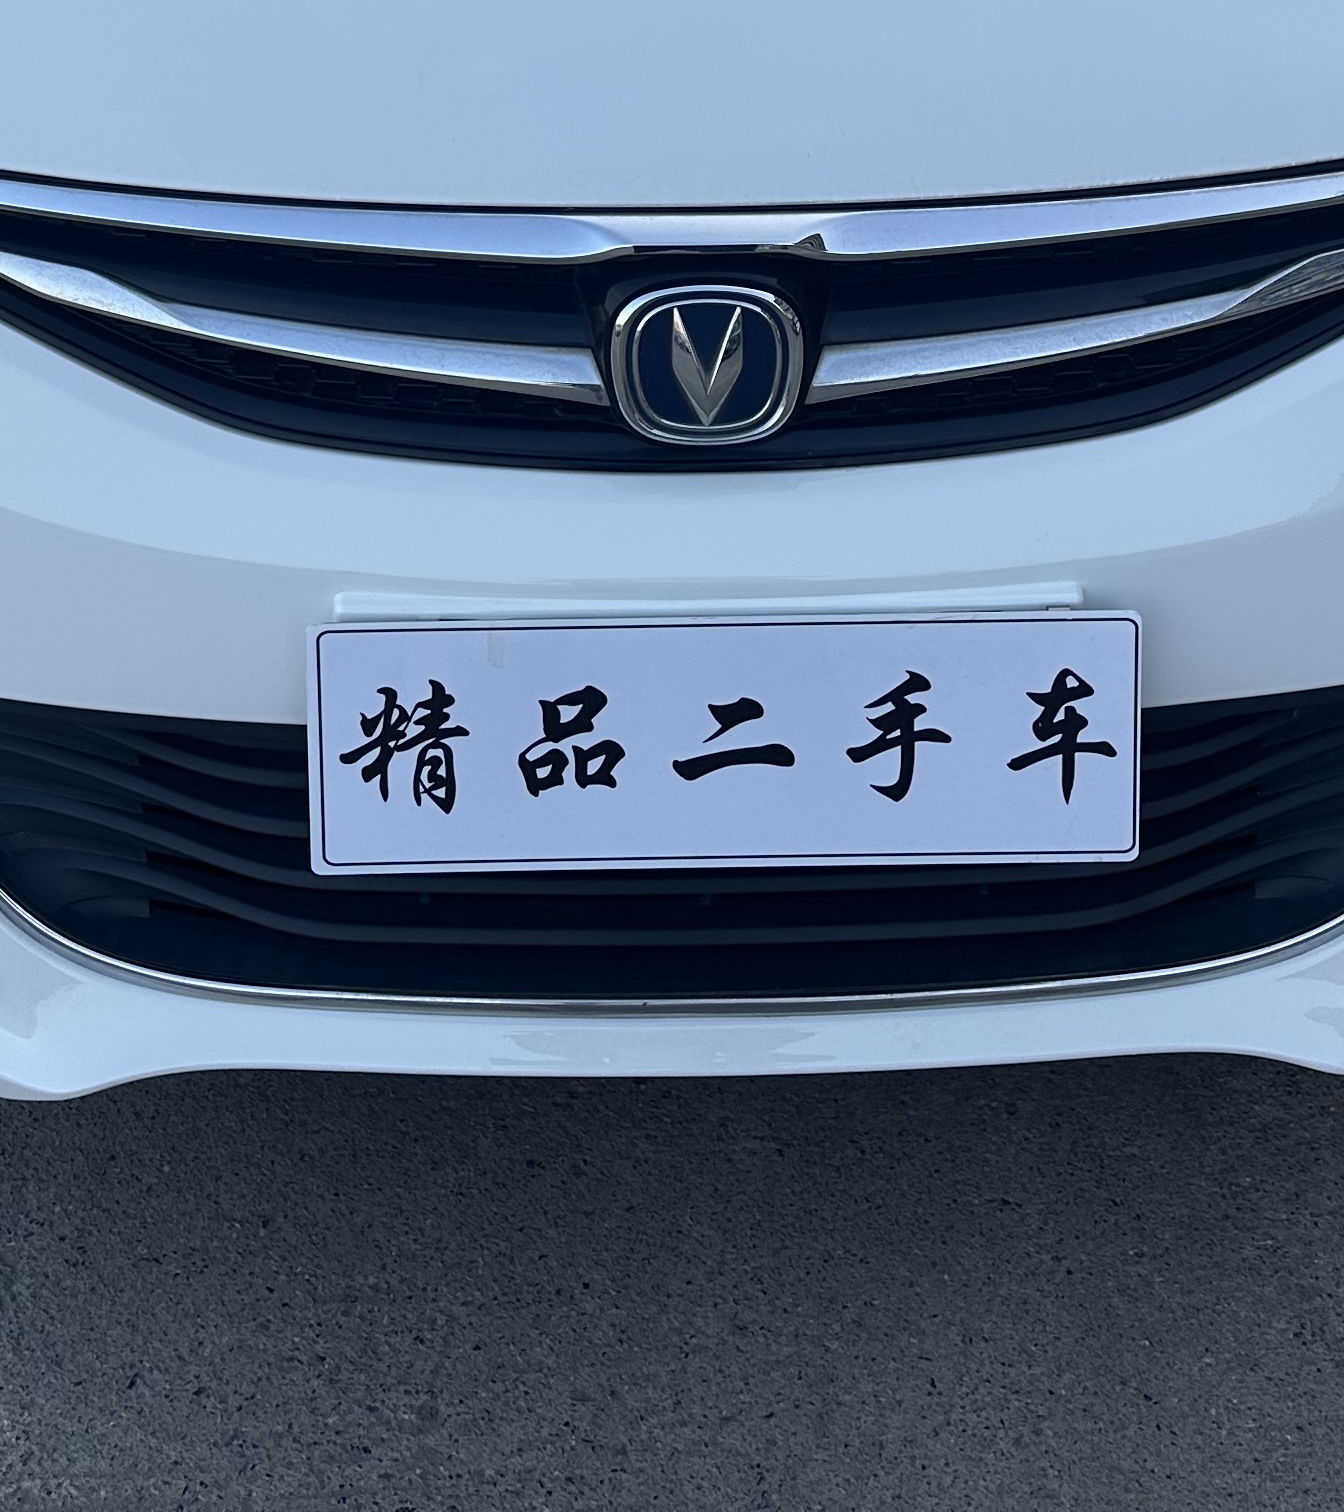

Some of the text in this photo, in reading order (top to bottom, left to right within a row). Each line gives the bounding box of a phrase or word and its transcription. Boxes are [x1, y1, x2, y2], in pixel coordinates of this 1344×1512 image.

[338, 668, 1118, 815] 精品二手车
